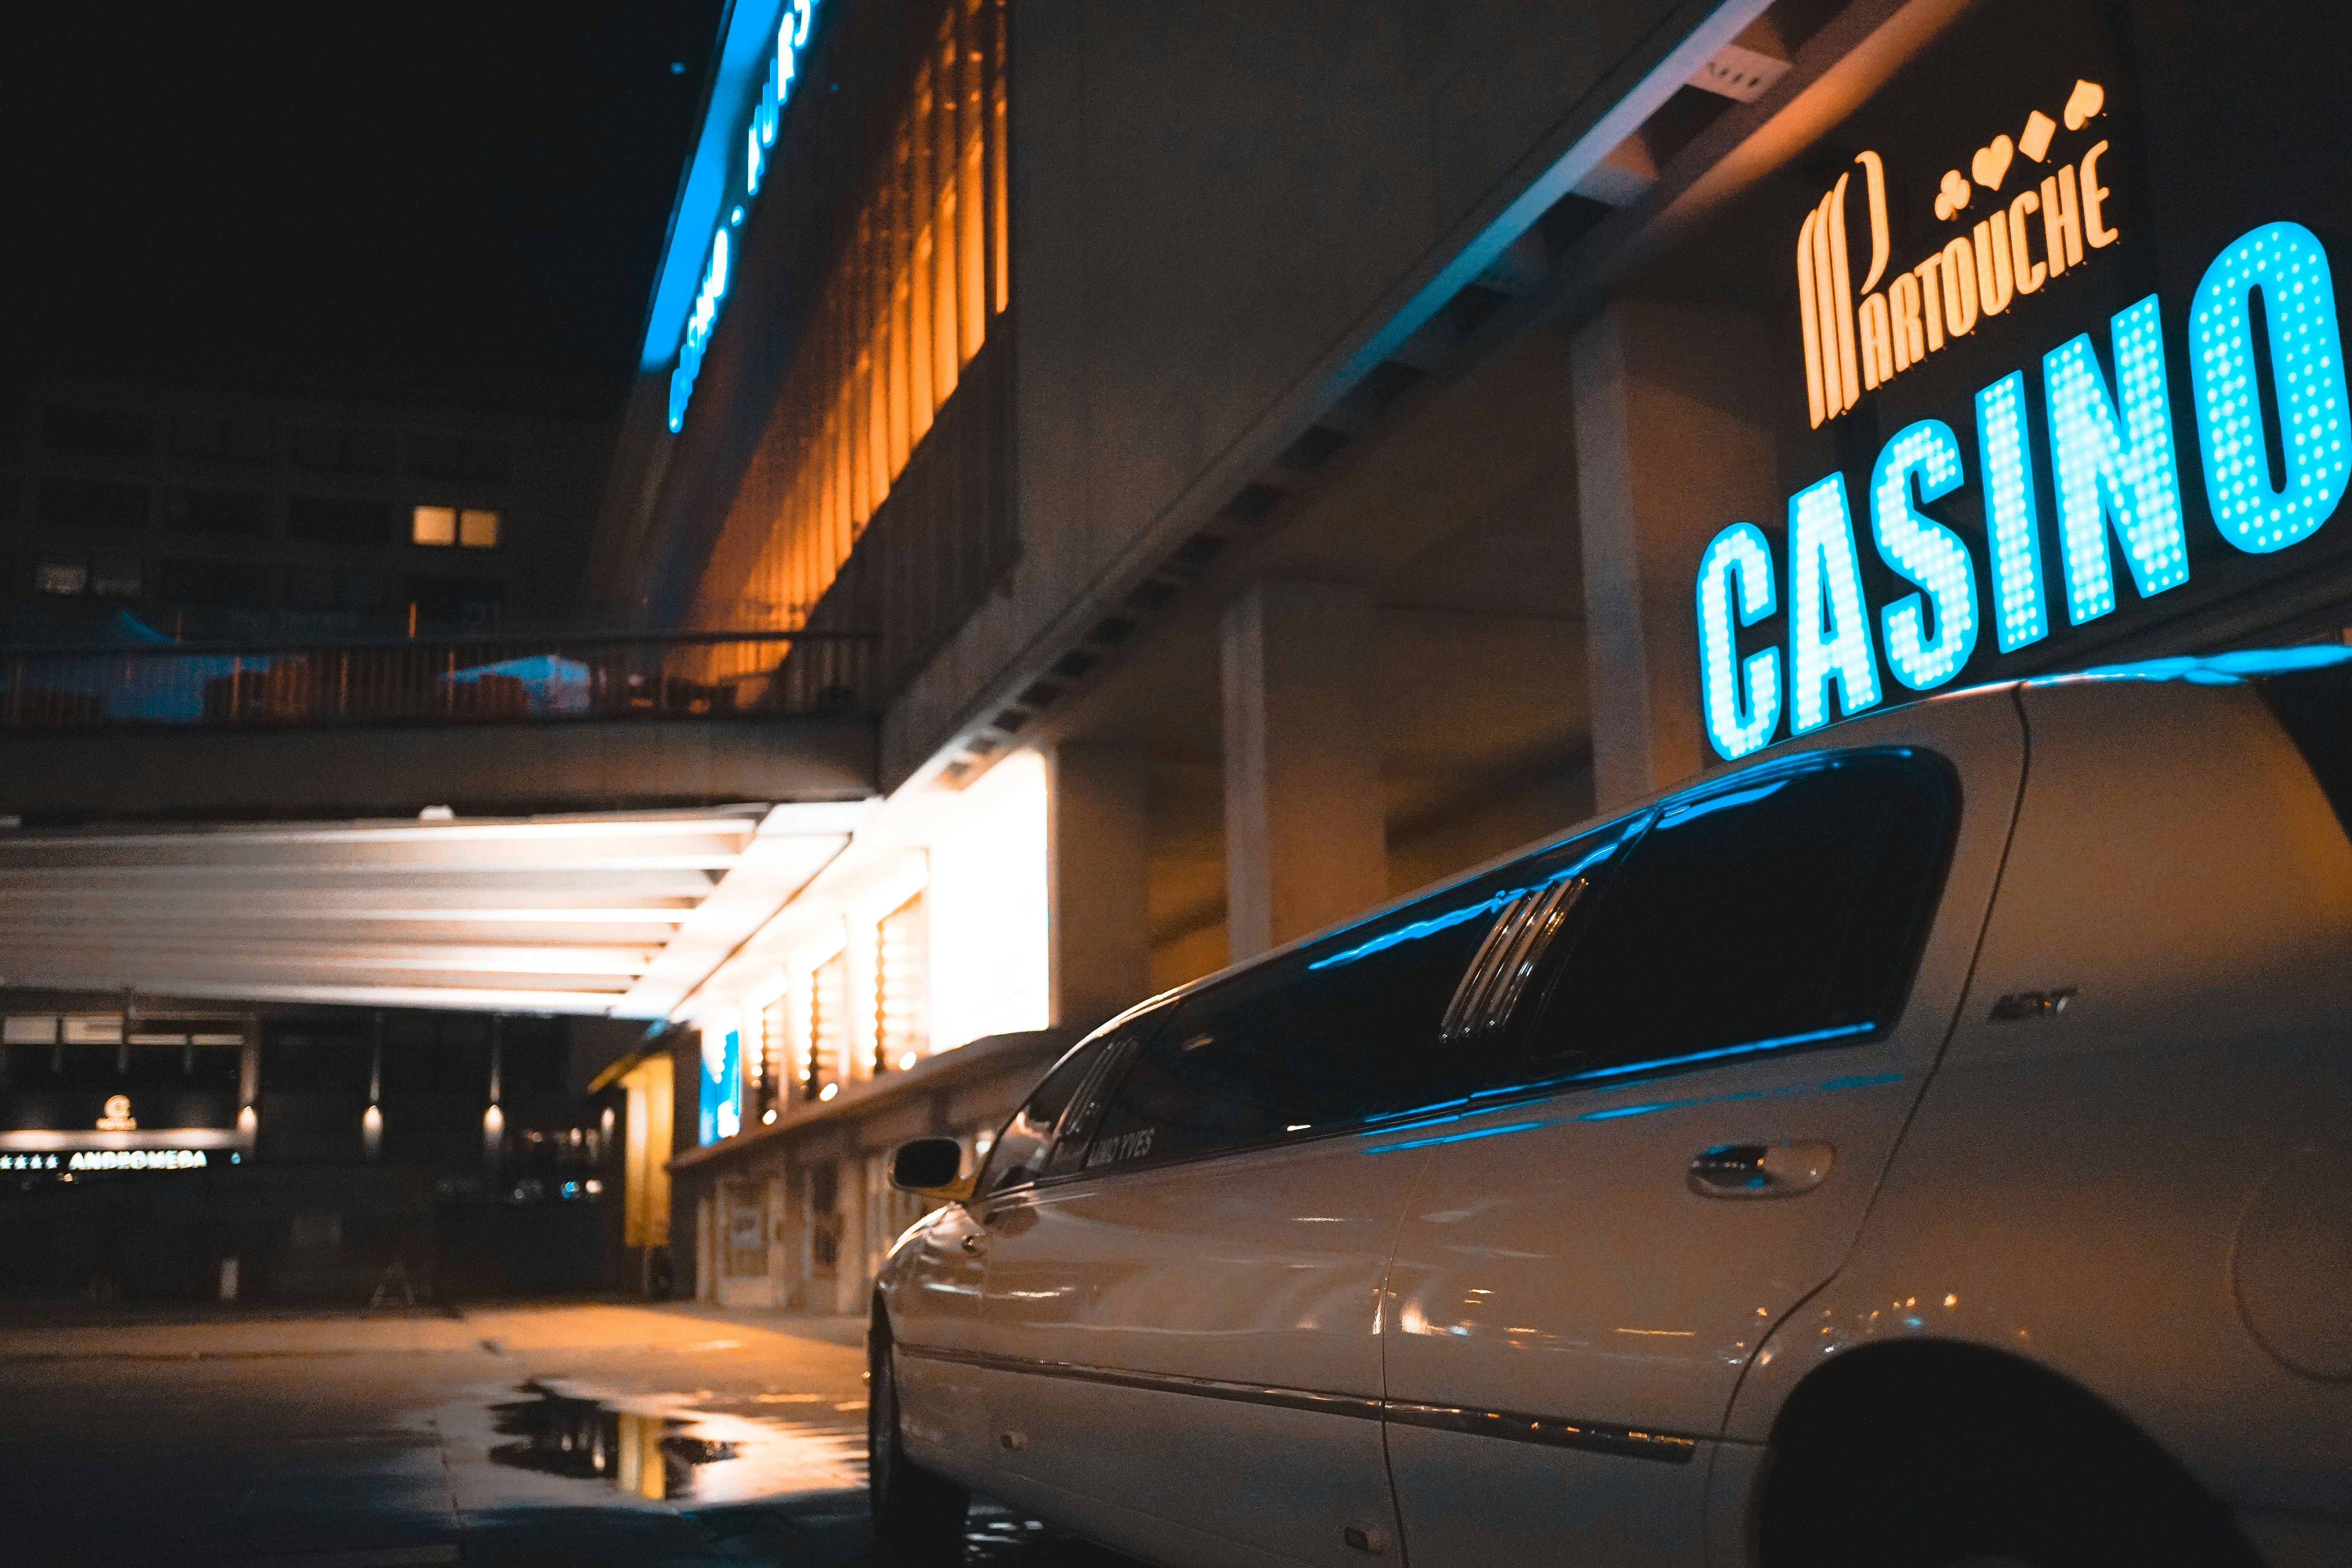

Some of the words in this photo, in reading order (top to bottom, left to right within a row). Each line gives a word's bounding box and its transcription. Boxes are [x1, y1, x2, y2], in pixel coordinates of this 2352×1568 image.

[1797, 139, 2118, 430] PARTOUCHE
[1696, 221, 2352, 760] CASINO
[69, 1150, 207, 1170] ANDROMEDA
[1119, 1127, 1155, 1160] YVES
